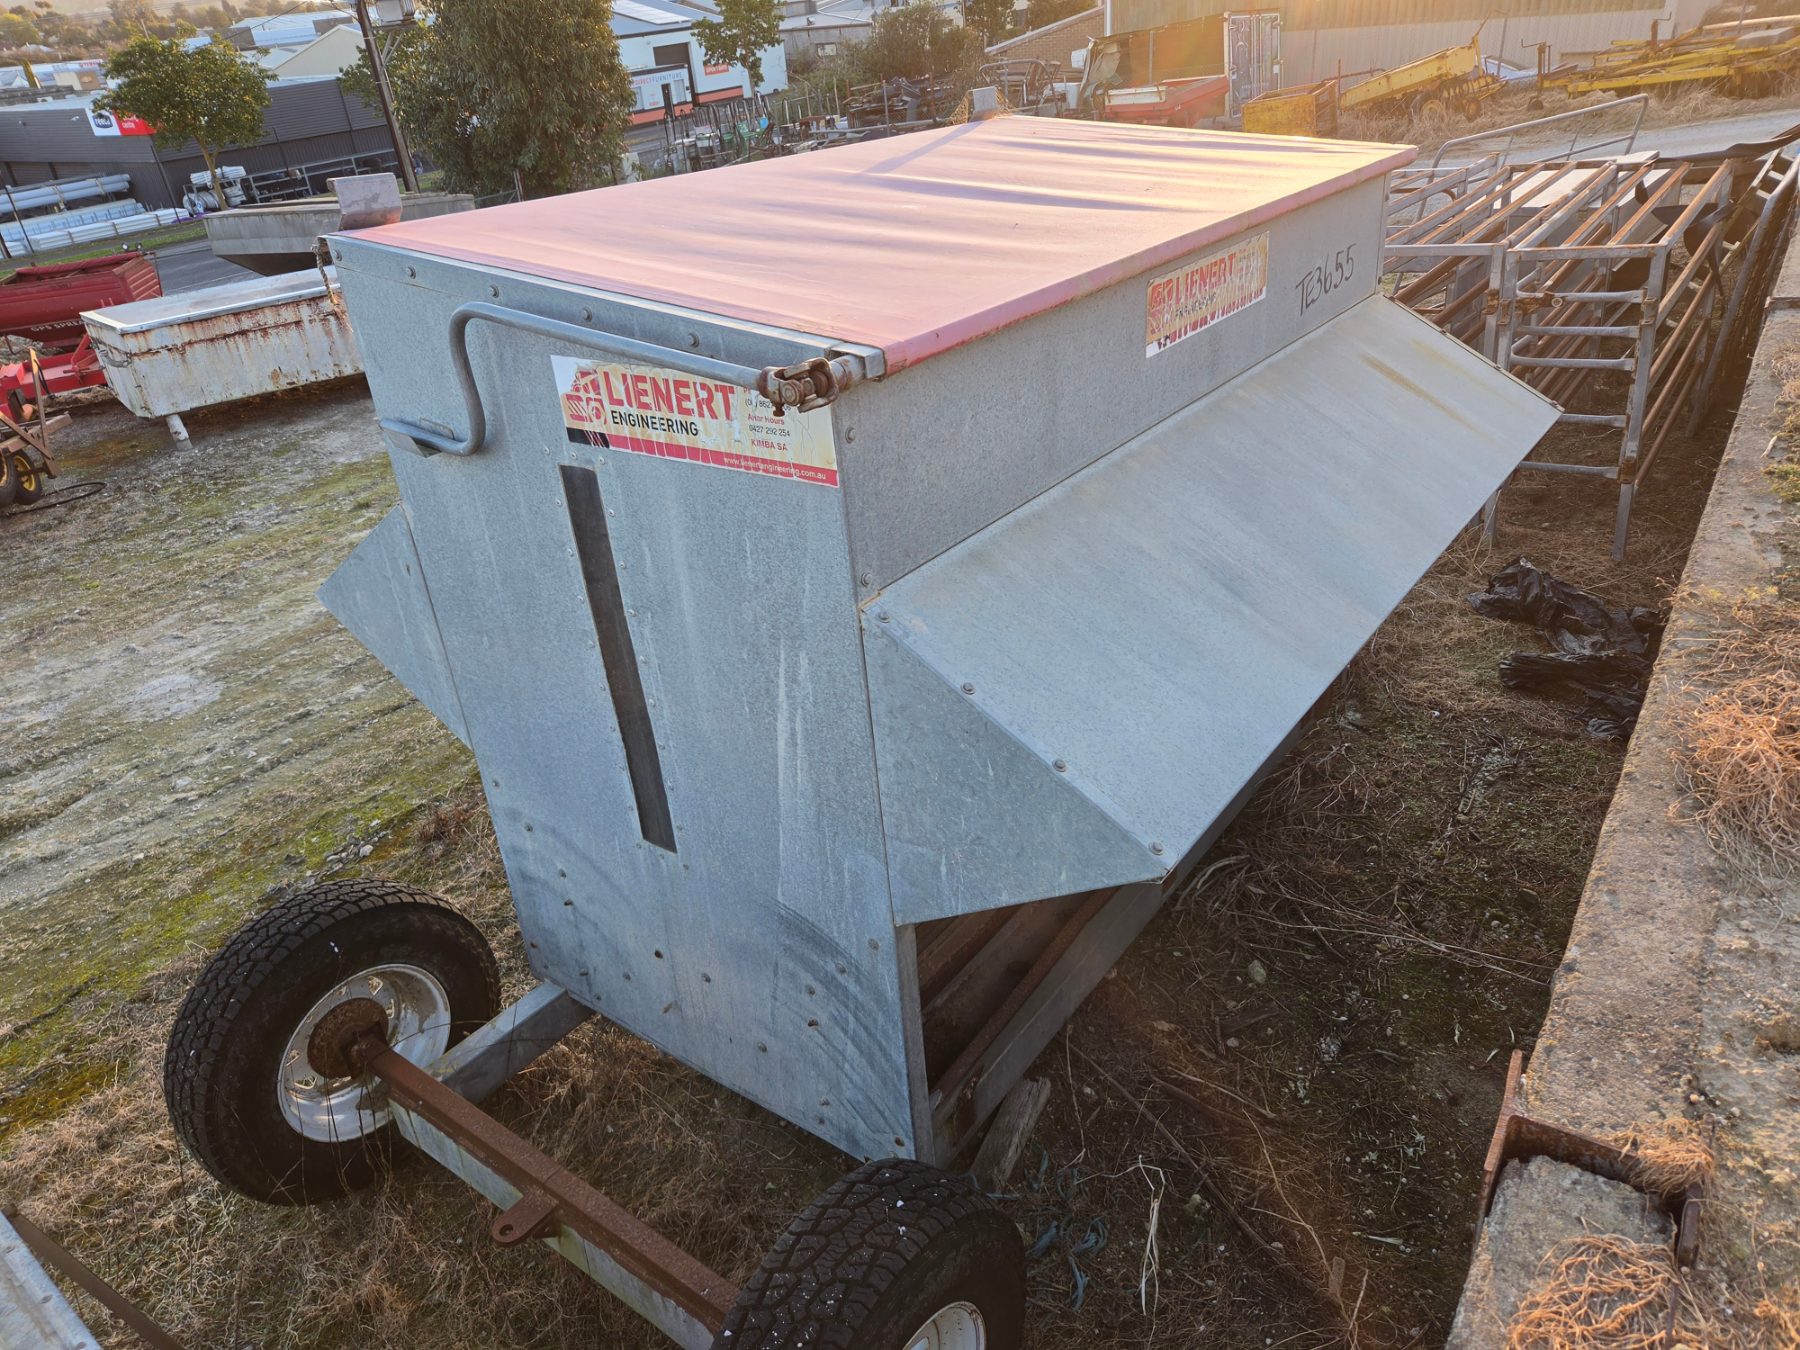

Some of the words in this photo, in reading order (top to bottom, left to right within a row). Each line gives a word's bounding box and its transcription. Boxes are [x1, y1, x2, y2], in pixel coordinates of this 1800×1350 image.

[1296, 243, 1357, 316] TE3655
[602, 371, 735, 421] LIENERT
[610, 410, 699, 436] ENGINEERING
[765, 426, 778, 436] 292
[751, 438, 776, 450] KIMBA
[777, 442, 789, 452] SA
